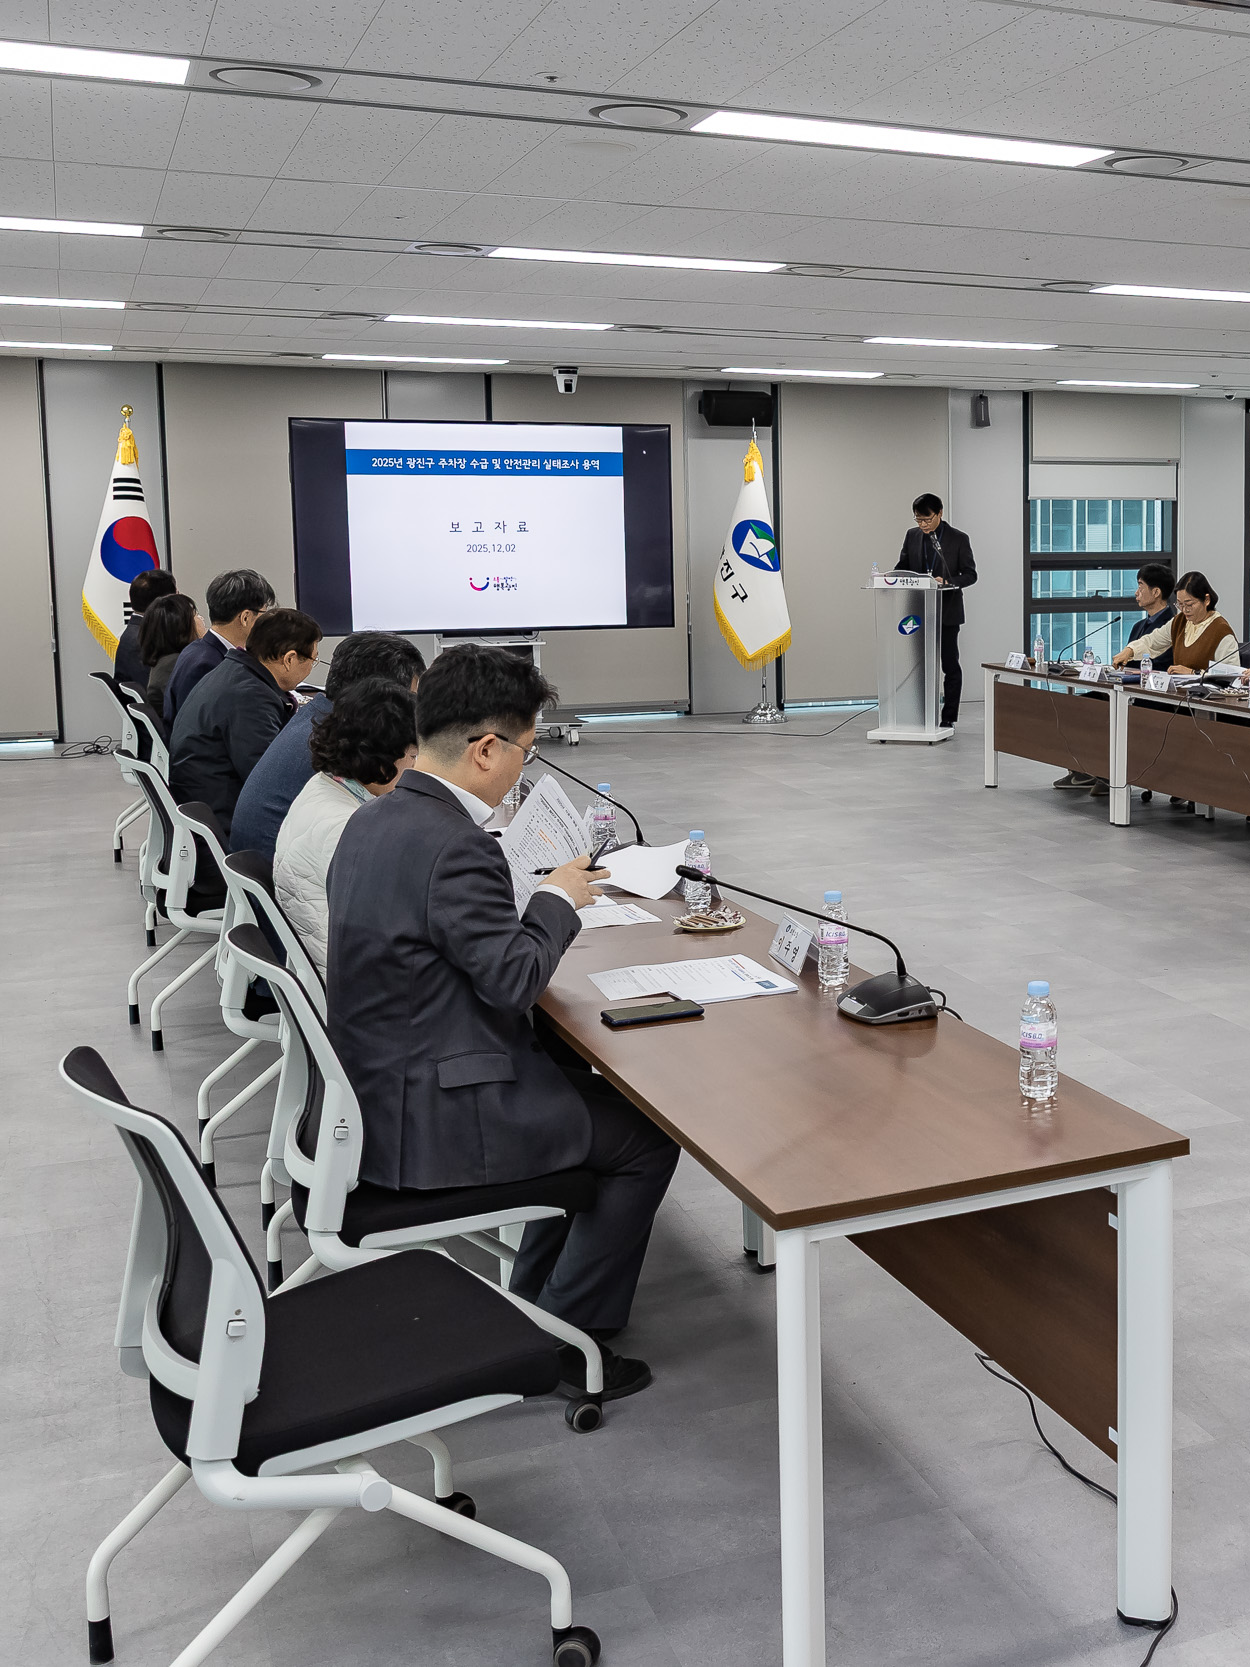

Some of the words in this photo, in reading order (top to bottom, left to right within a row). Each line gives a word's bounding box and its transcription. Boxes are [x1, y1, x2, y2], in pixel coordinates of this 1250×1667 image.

[372, 457, 403, 469] 2025년
[406, 457, 435, 469] 광진구
[438, 457, 467, 469] 주차장
[470, 458, 489, 470] 수급
[492, 458, 501, 470] 및
[504, 458, 541, 470] 안전관리
[543, 458, 579, 470] 실태조사
[582, 459, 600, 471] 용역
